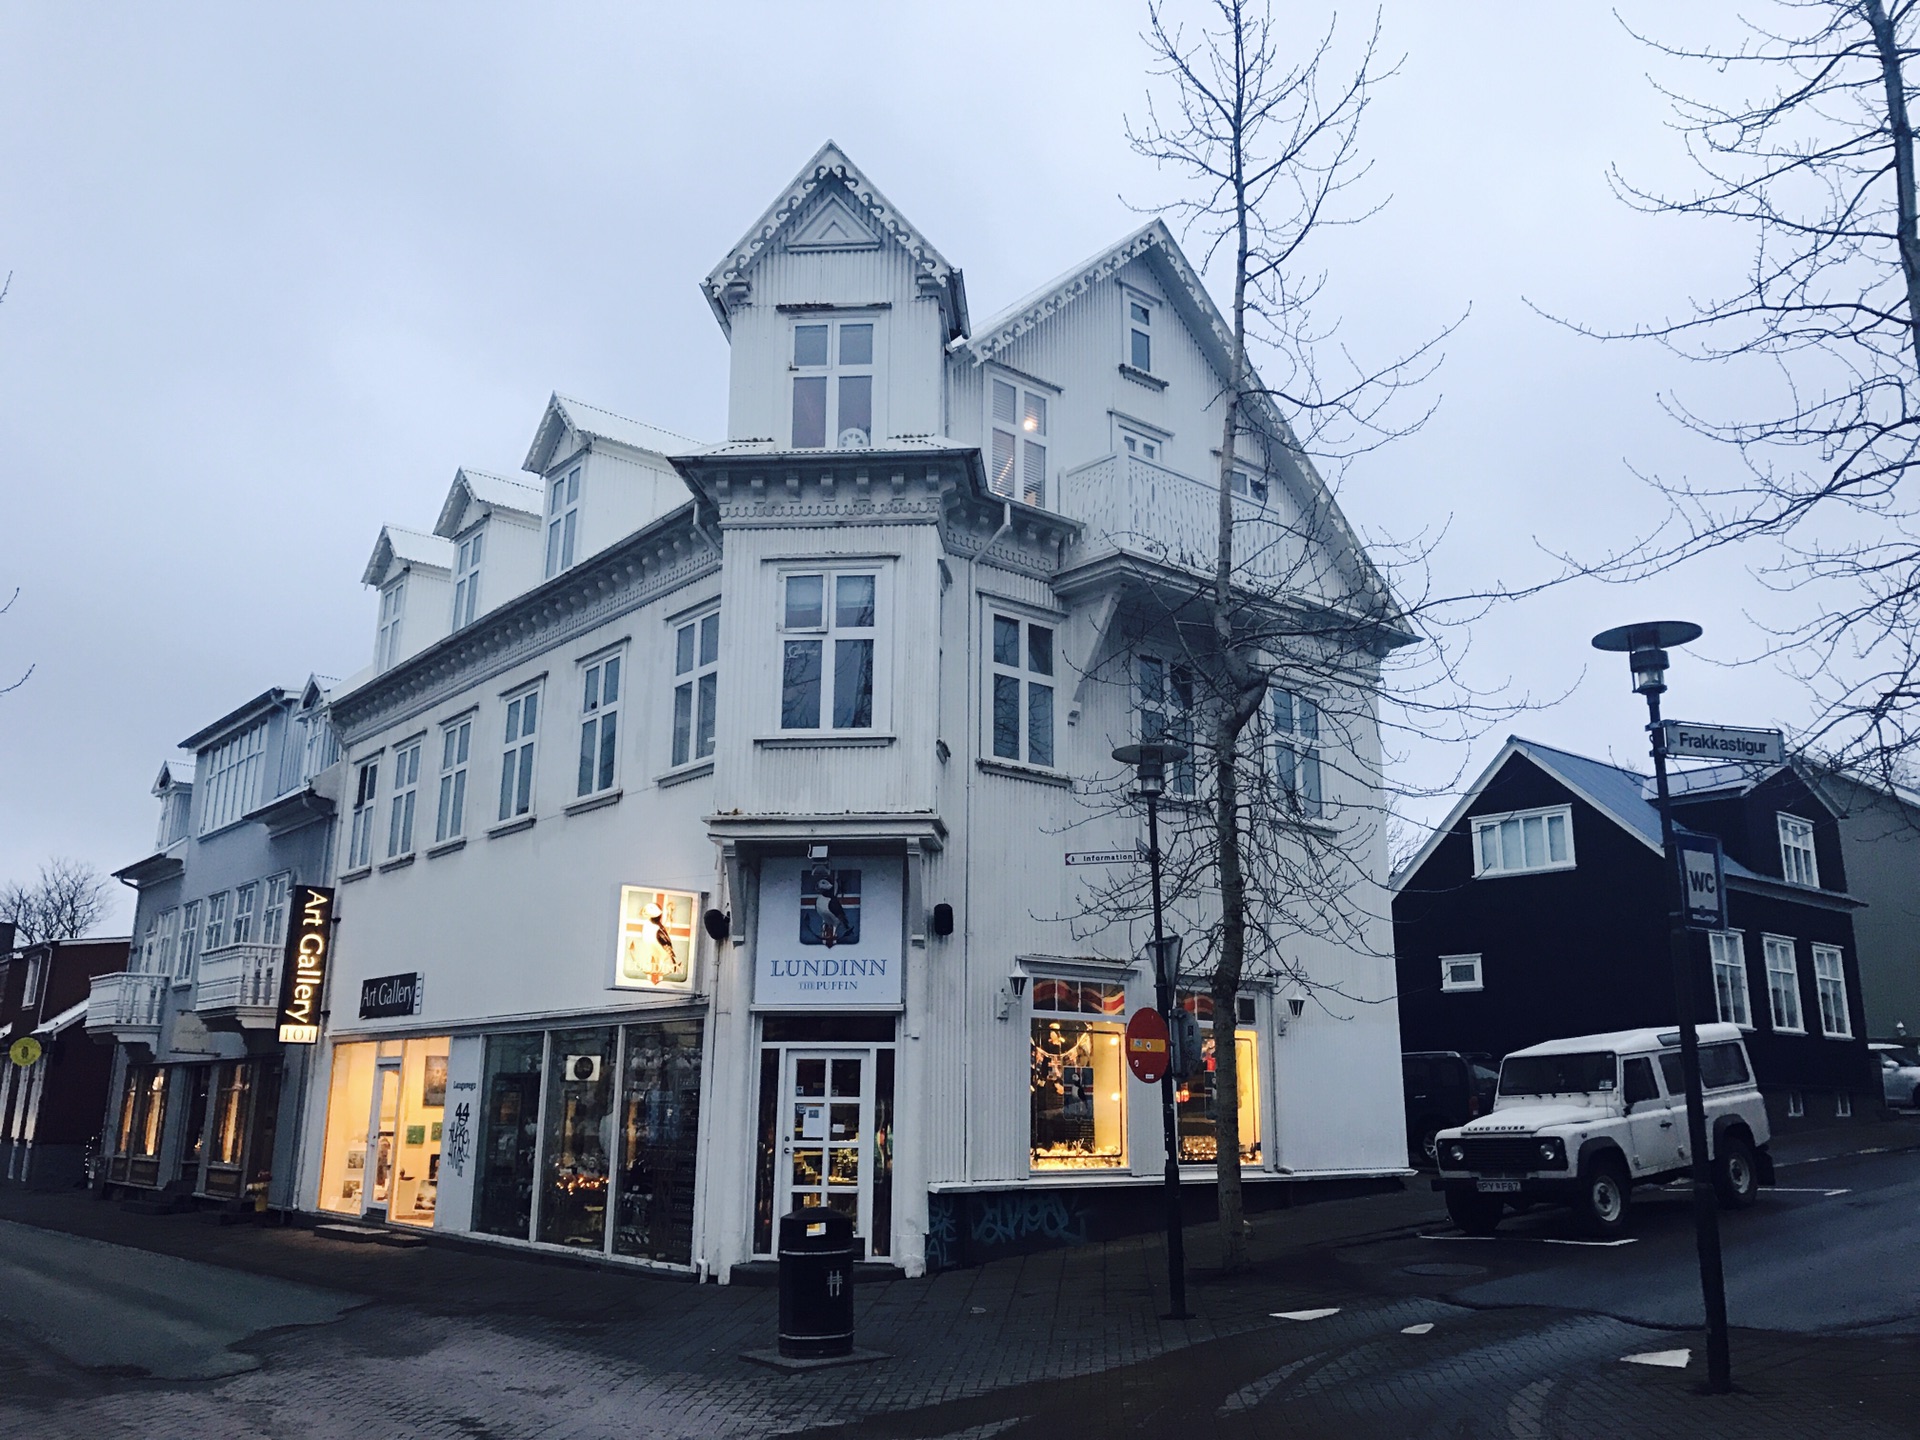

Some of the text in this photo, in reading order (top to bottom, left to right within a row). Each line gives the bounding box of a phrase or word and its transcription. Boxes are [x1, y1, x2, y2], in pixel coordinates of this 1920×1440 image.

[1083, 854, 1133, 862] Information
[1689, 870, 1715, 893] WC
[285, 889, 328, 1024] Art Gallery
[770, 959, 887, 977] LUNDINN
[361, 979, 415, 1010] Art Gallery
[816, 981, 858, 990] PUFFIN
[284, 1028, 313, 1041] 101
[455, 1103, 470, 1121] 44
